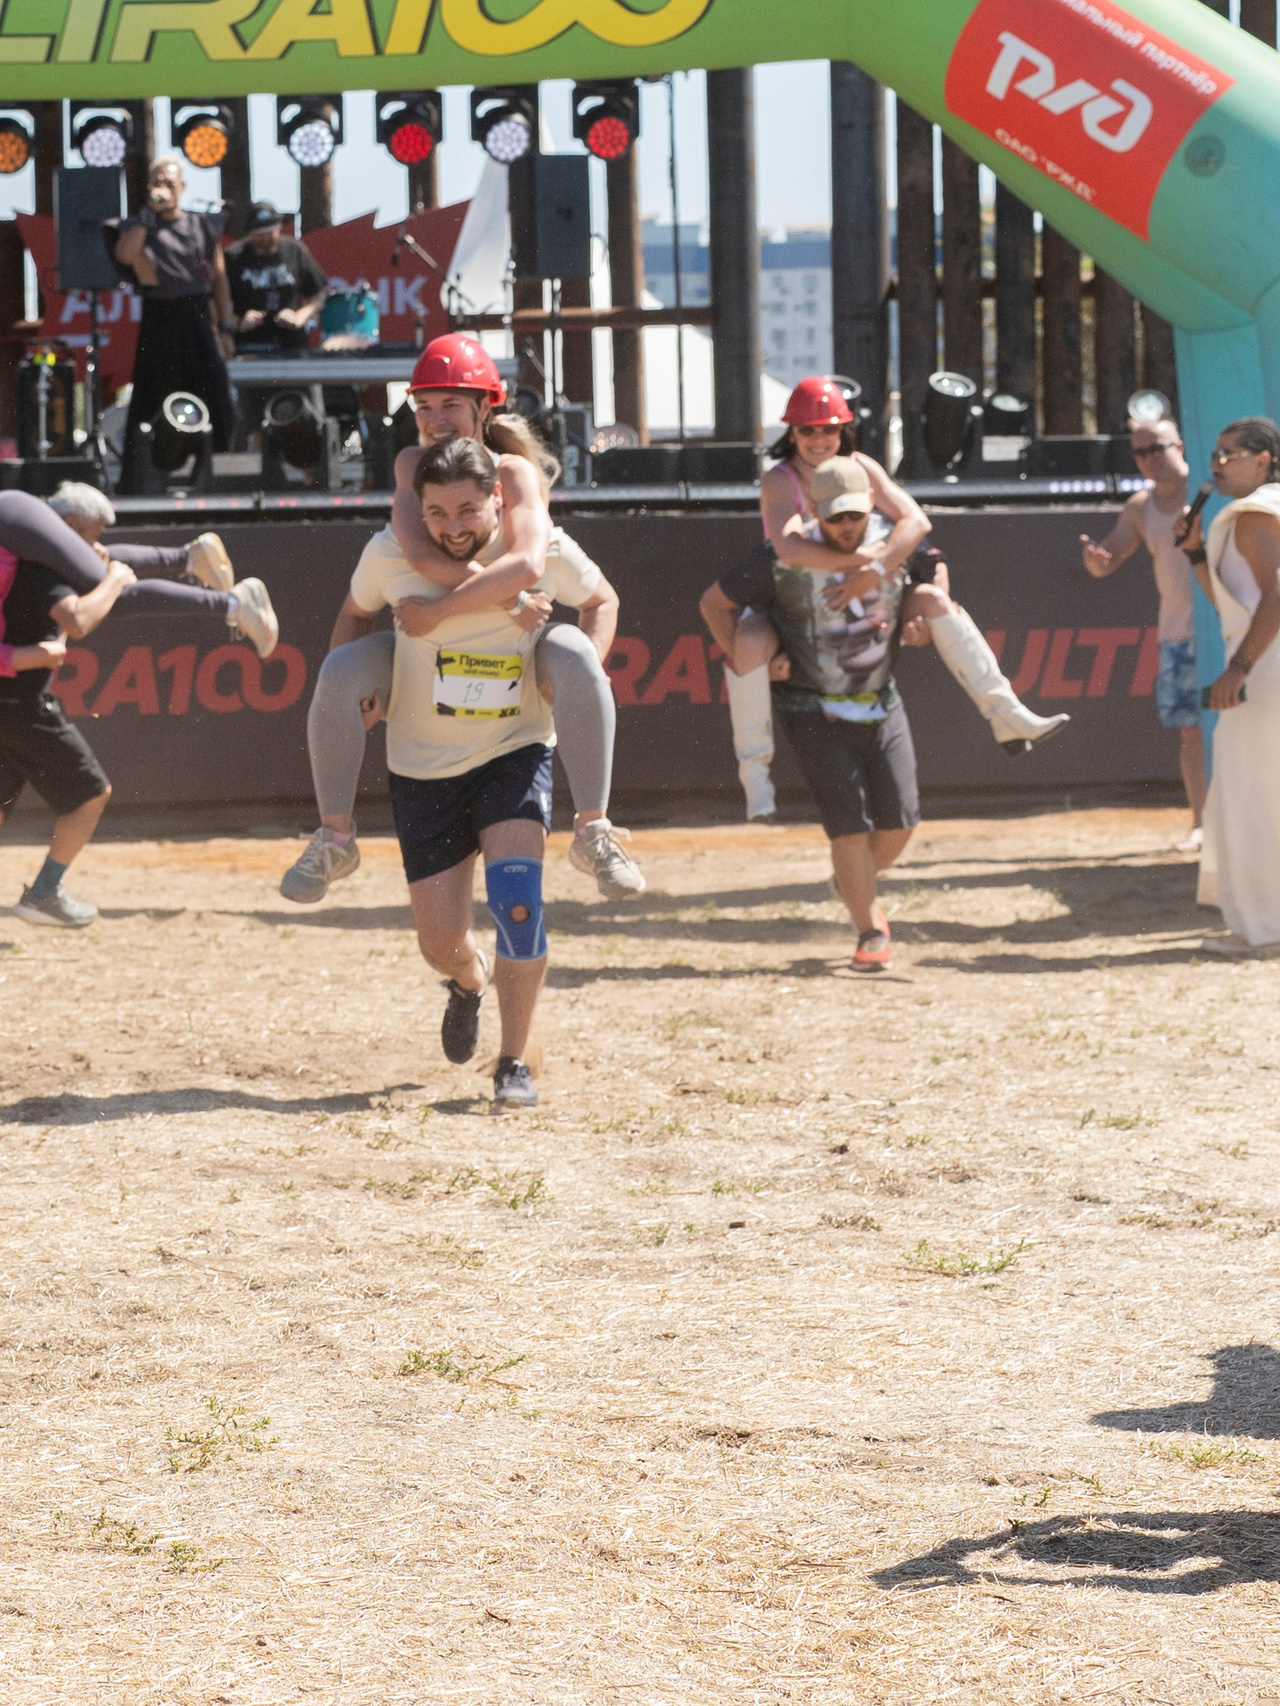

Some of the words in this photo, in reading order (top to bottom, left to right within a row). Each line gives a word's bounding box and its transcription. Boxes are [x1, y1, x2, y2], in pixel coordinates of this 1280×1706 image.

[1060, 0, 1144, 48] альный
[1139, 40, 1218, 95] партнёр
[459, 654, 506, 669] Привет
[461, 681, 485, 703] 19
